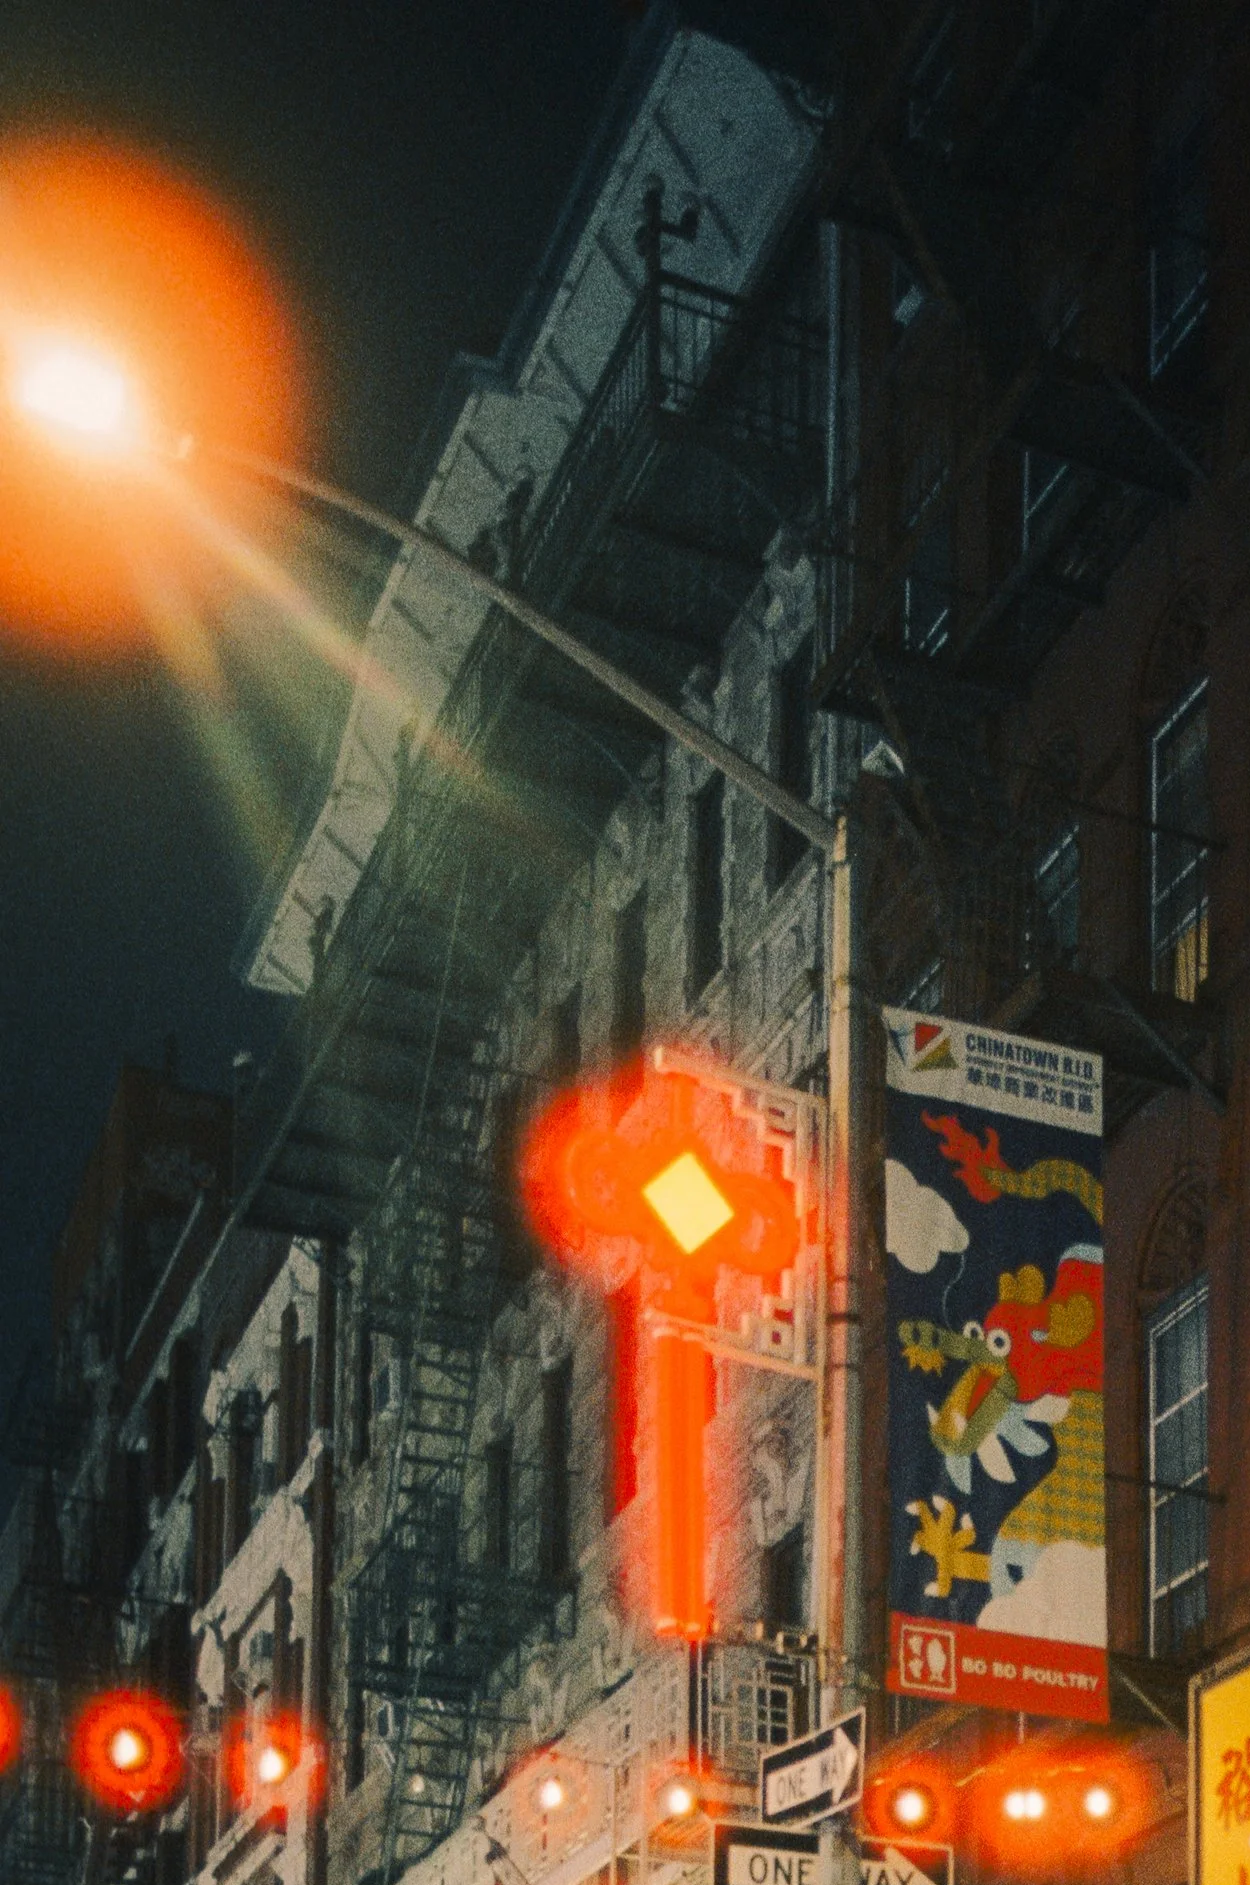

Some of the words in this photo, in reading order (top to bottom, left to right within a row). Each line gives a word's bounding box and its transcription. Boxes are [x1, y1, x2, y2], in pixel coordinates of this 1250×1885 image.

[965, 1032, 1060, 1072] CHINATOWN
[961, 1656, 987, 1675] BO
[992, 1661, 1017, 1679] BO
[1022, 1665, 1099, 1691] POULTRY
[775, 1766, 807, 1807] ONE
[820, 1750, 848, 1790] WAY
